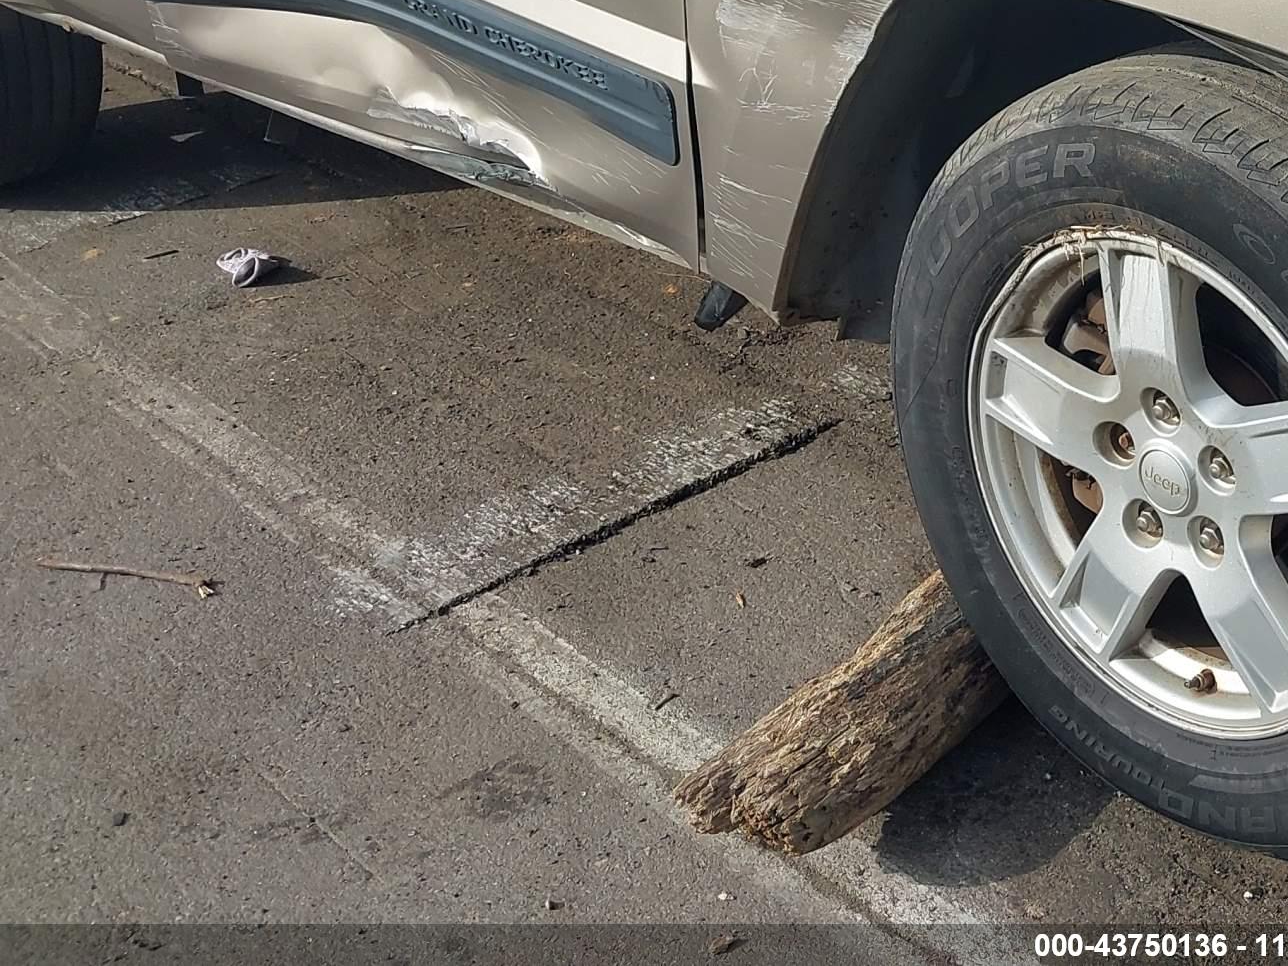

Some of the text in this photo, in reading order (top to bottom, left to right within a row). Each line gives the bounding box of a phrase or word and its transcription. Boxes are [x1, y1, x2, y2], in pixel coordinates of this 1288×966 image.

[483, 25, 609, 91] CHEROKEE
[1144, 465, 1181, 497] Jeep
[1047, 704, 1167, 792] TOURING
